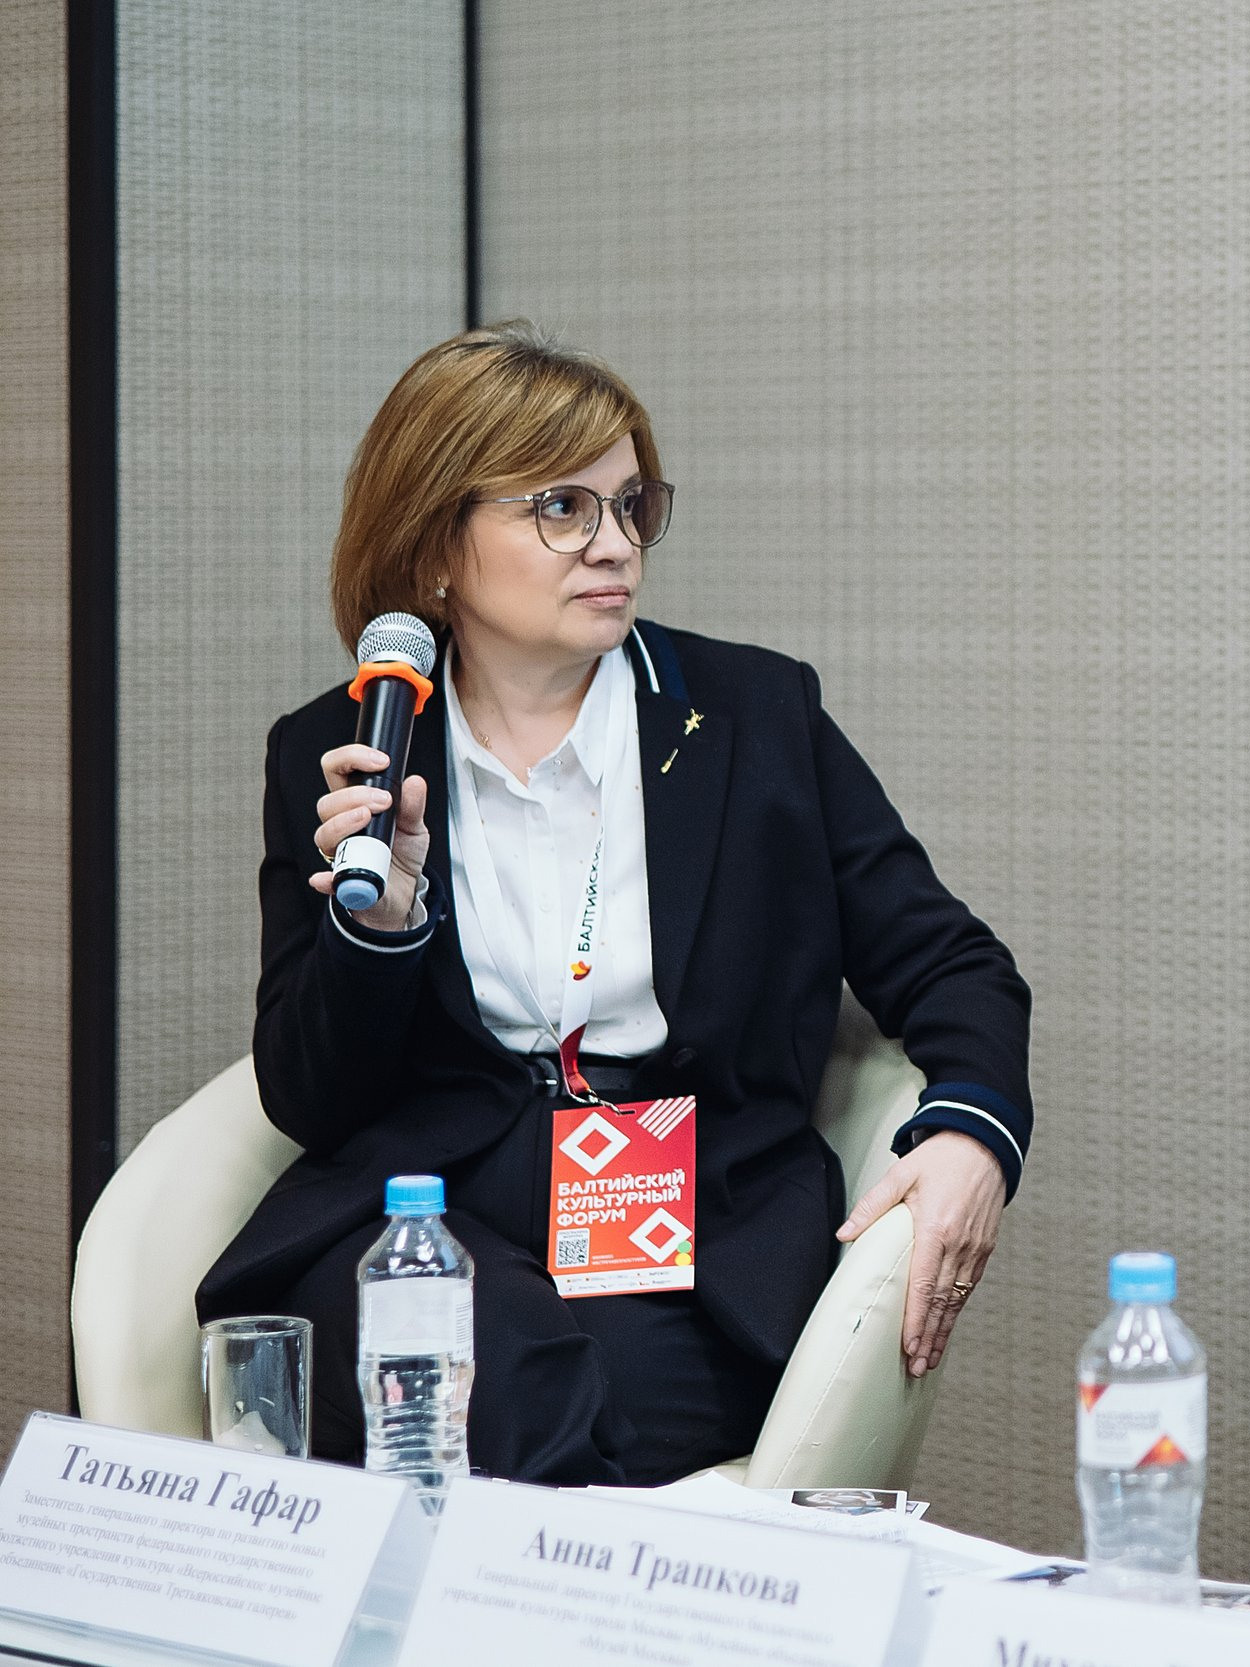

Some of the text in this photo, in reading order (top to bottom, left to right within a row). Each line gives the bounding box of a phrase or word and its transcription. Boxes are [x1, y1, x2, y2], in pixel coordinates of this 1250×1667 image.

[557, 1186, 681, 1212] КУЛЬТУРНЫЙ
[558, 1168, 686, 1197] БАЛТИЙСКИЙ
[556, 1208, 626, 1227] ФОРУМ
[58, 1443, 321, 1534] Татьяна Гафар
[23, 1489, 85, 1513] Заместитель
[86, 1504, 158, 1527] генерального
[522, 1524, 802, 1606] Анна Трапкова
